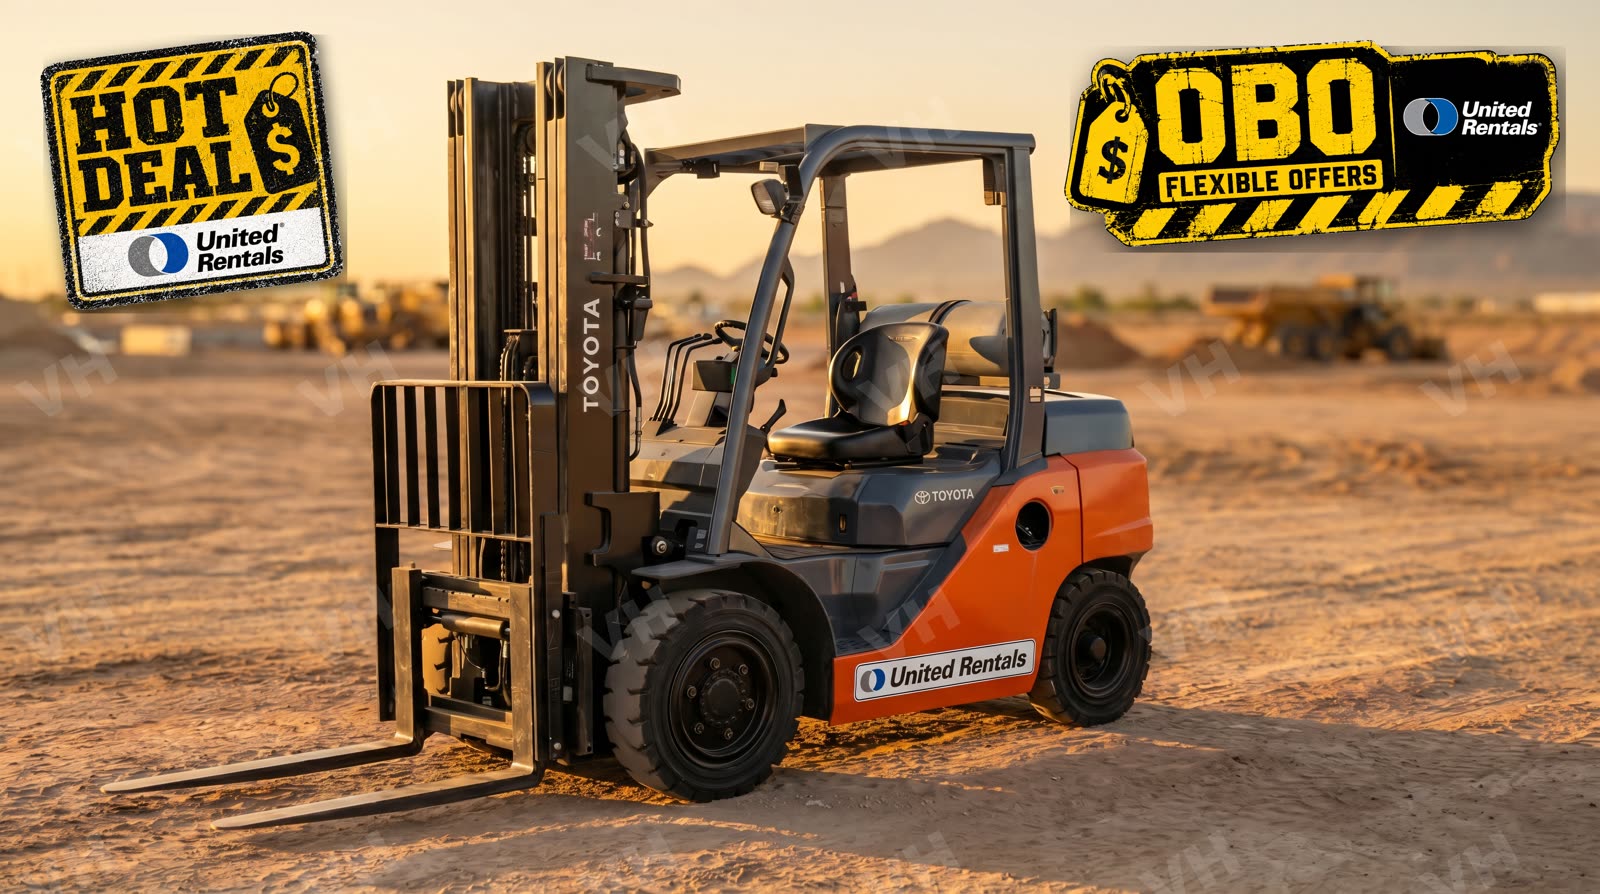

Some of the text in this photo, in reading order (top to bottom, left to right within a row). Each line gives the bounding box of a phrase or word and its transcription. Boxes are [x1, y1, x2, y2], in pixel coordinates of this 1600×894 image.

[583, 298, 600, 412] TOYOTA
[932, 488, 974, 501] TOYOTA
[890, 650, 1026, 688] United Rentals
